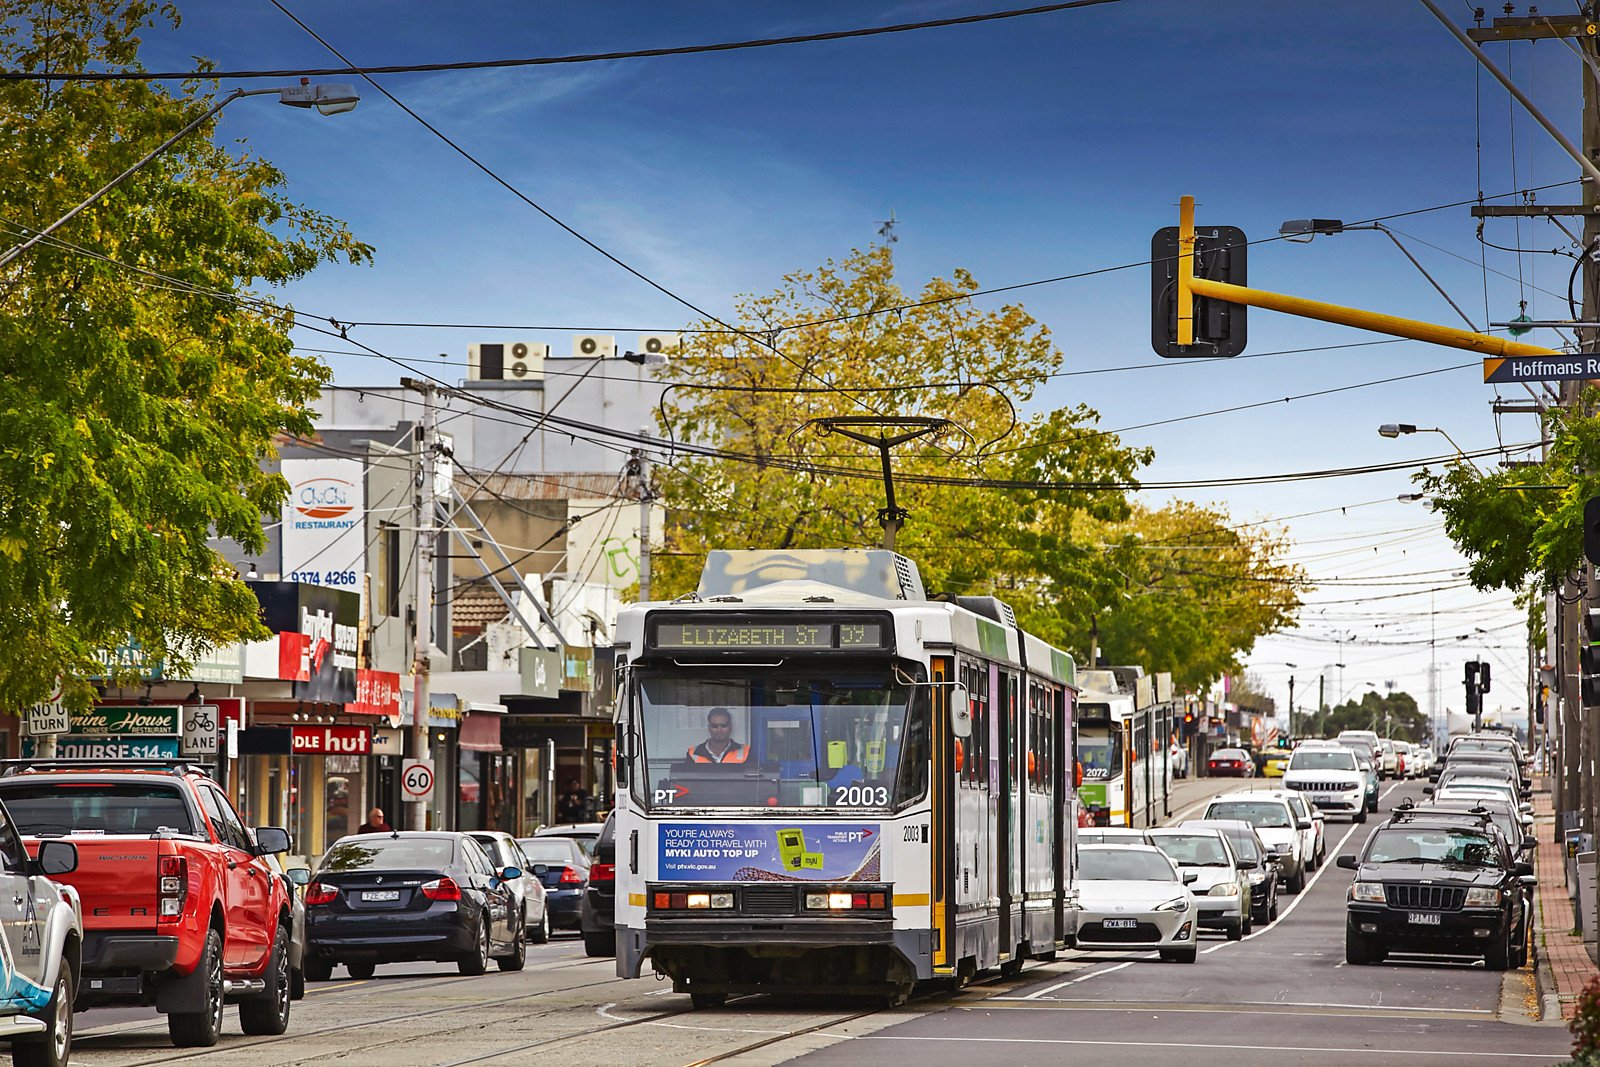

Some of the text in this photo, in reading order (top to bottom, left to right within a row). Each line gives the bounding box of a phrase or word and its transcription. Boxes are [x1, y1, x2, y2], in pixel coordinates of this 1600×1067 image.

[1512, 361, 1583, 377] Hoffmans
[295, 520, 354, 530] RESTAURANT
[291, 571, 357, 586] 9374 4266
[682, 624, 785, 645] ELIZABETH
[31, 702, 66, 717] NO U
[32, 718, 65, 731] TURN
[109, 712, 172, 731] House
[185, 736, 215, 749] LANE
[325, 729, 367, 751] hut
[55, 744, 129, 759] COURSE
[407, 772, 429, 788] 60
[1086, 768, 1108, 777] 2072
[835, 786, 888, 806] 2003
[665, 829, 735, 838] YOU'RE ALWAYS
[903, 825, 920, 842] 2003
[665, 839, 767, 848] READY TO TRAVEL WITH
[665, 849, 759, 858] MYKI AUTO TOP UP
[677, 863, 717, 871] ptv.vic.gov.au
